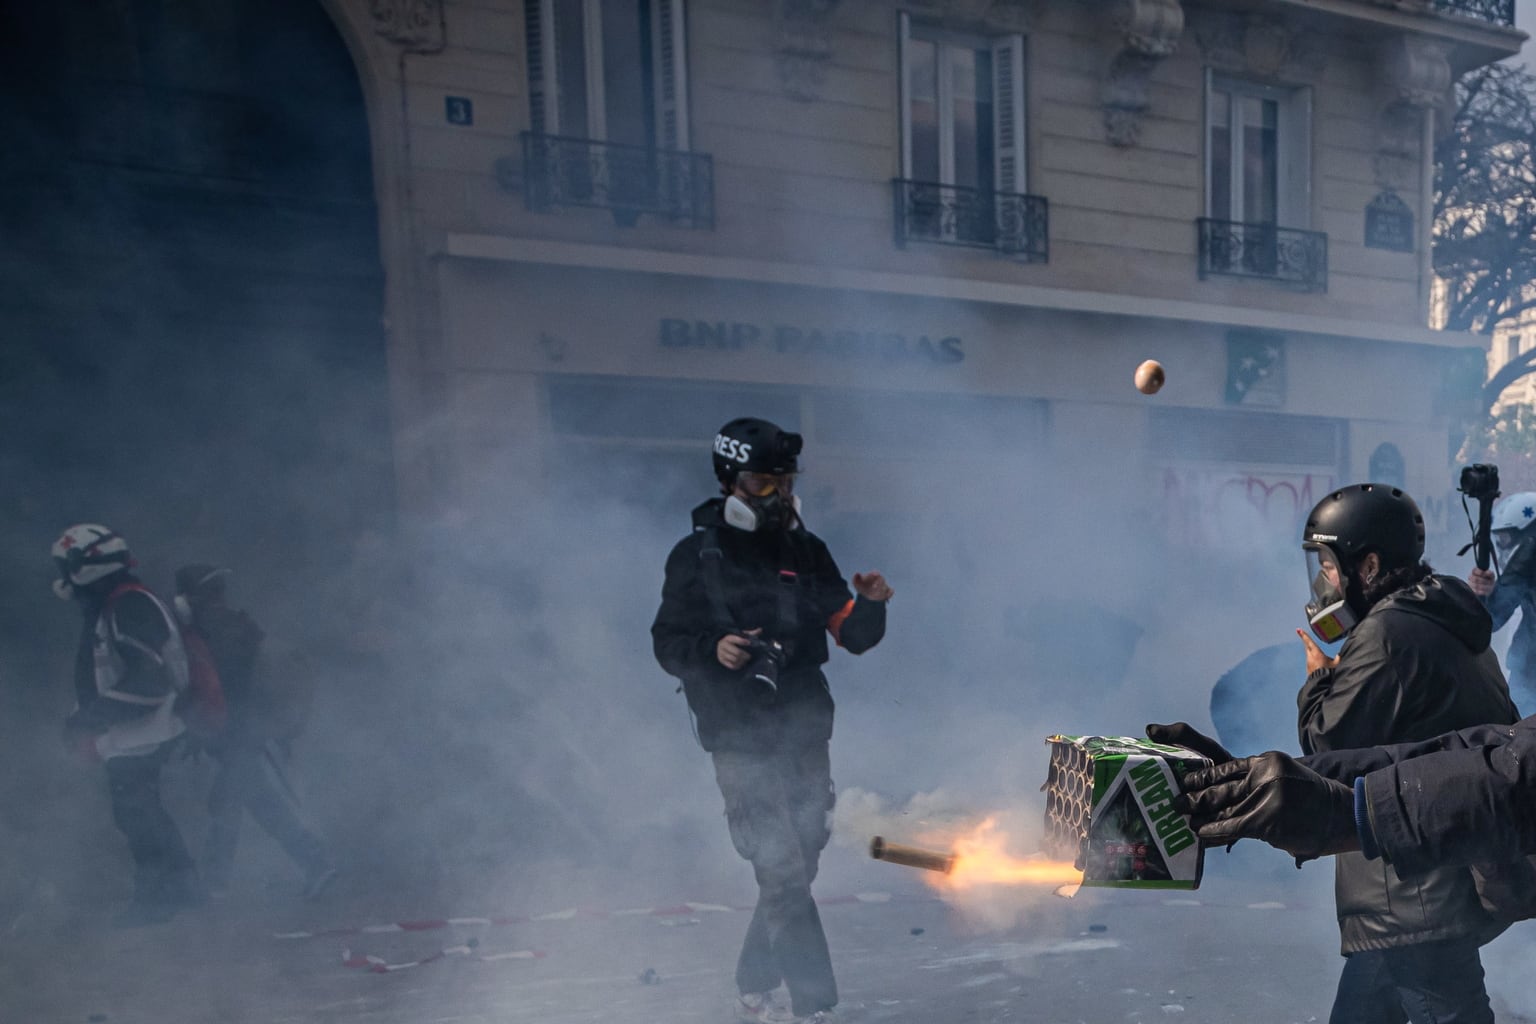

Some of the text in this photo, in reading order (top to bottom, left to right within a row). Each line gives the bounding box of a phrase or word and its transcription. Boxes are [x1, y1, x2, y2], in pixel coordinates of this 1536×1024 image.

[452, 101, 466, 122] 3
[659, 318, 965, 364] BNP PARIBAS
[713, 433, 753, 464] RESS
